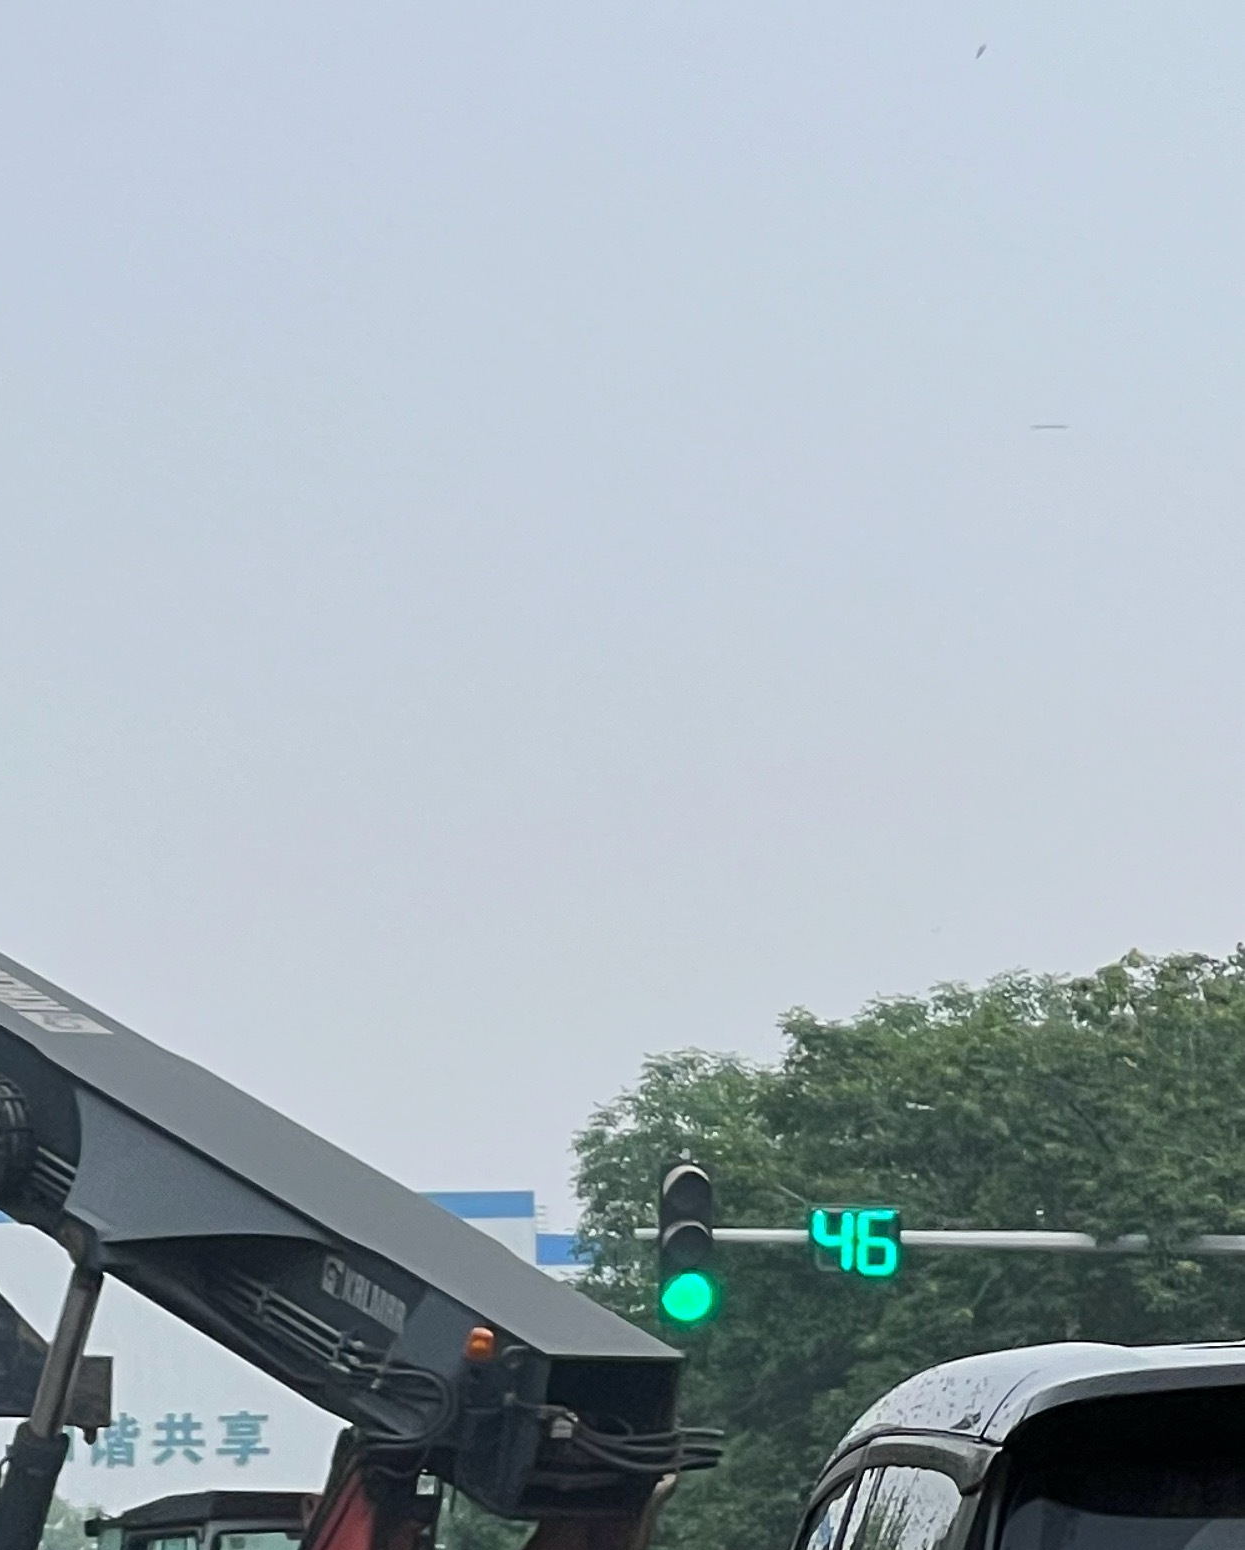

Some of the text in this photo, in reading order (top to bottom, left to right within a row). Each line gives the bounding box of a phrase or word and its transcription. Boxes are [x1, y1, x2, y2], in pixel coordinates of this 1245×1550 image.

[812, 1209, 897, 1276] 46
[63, 1410, 270, 1468] 谐共享
